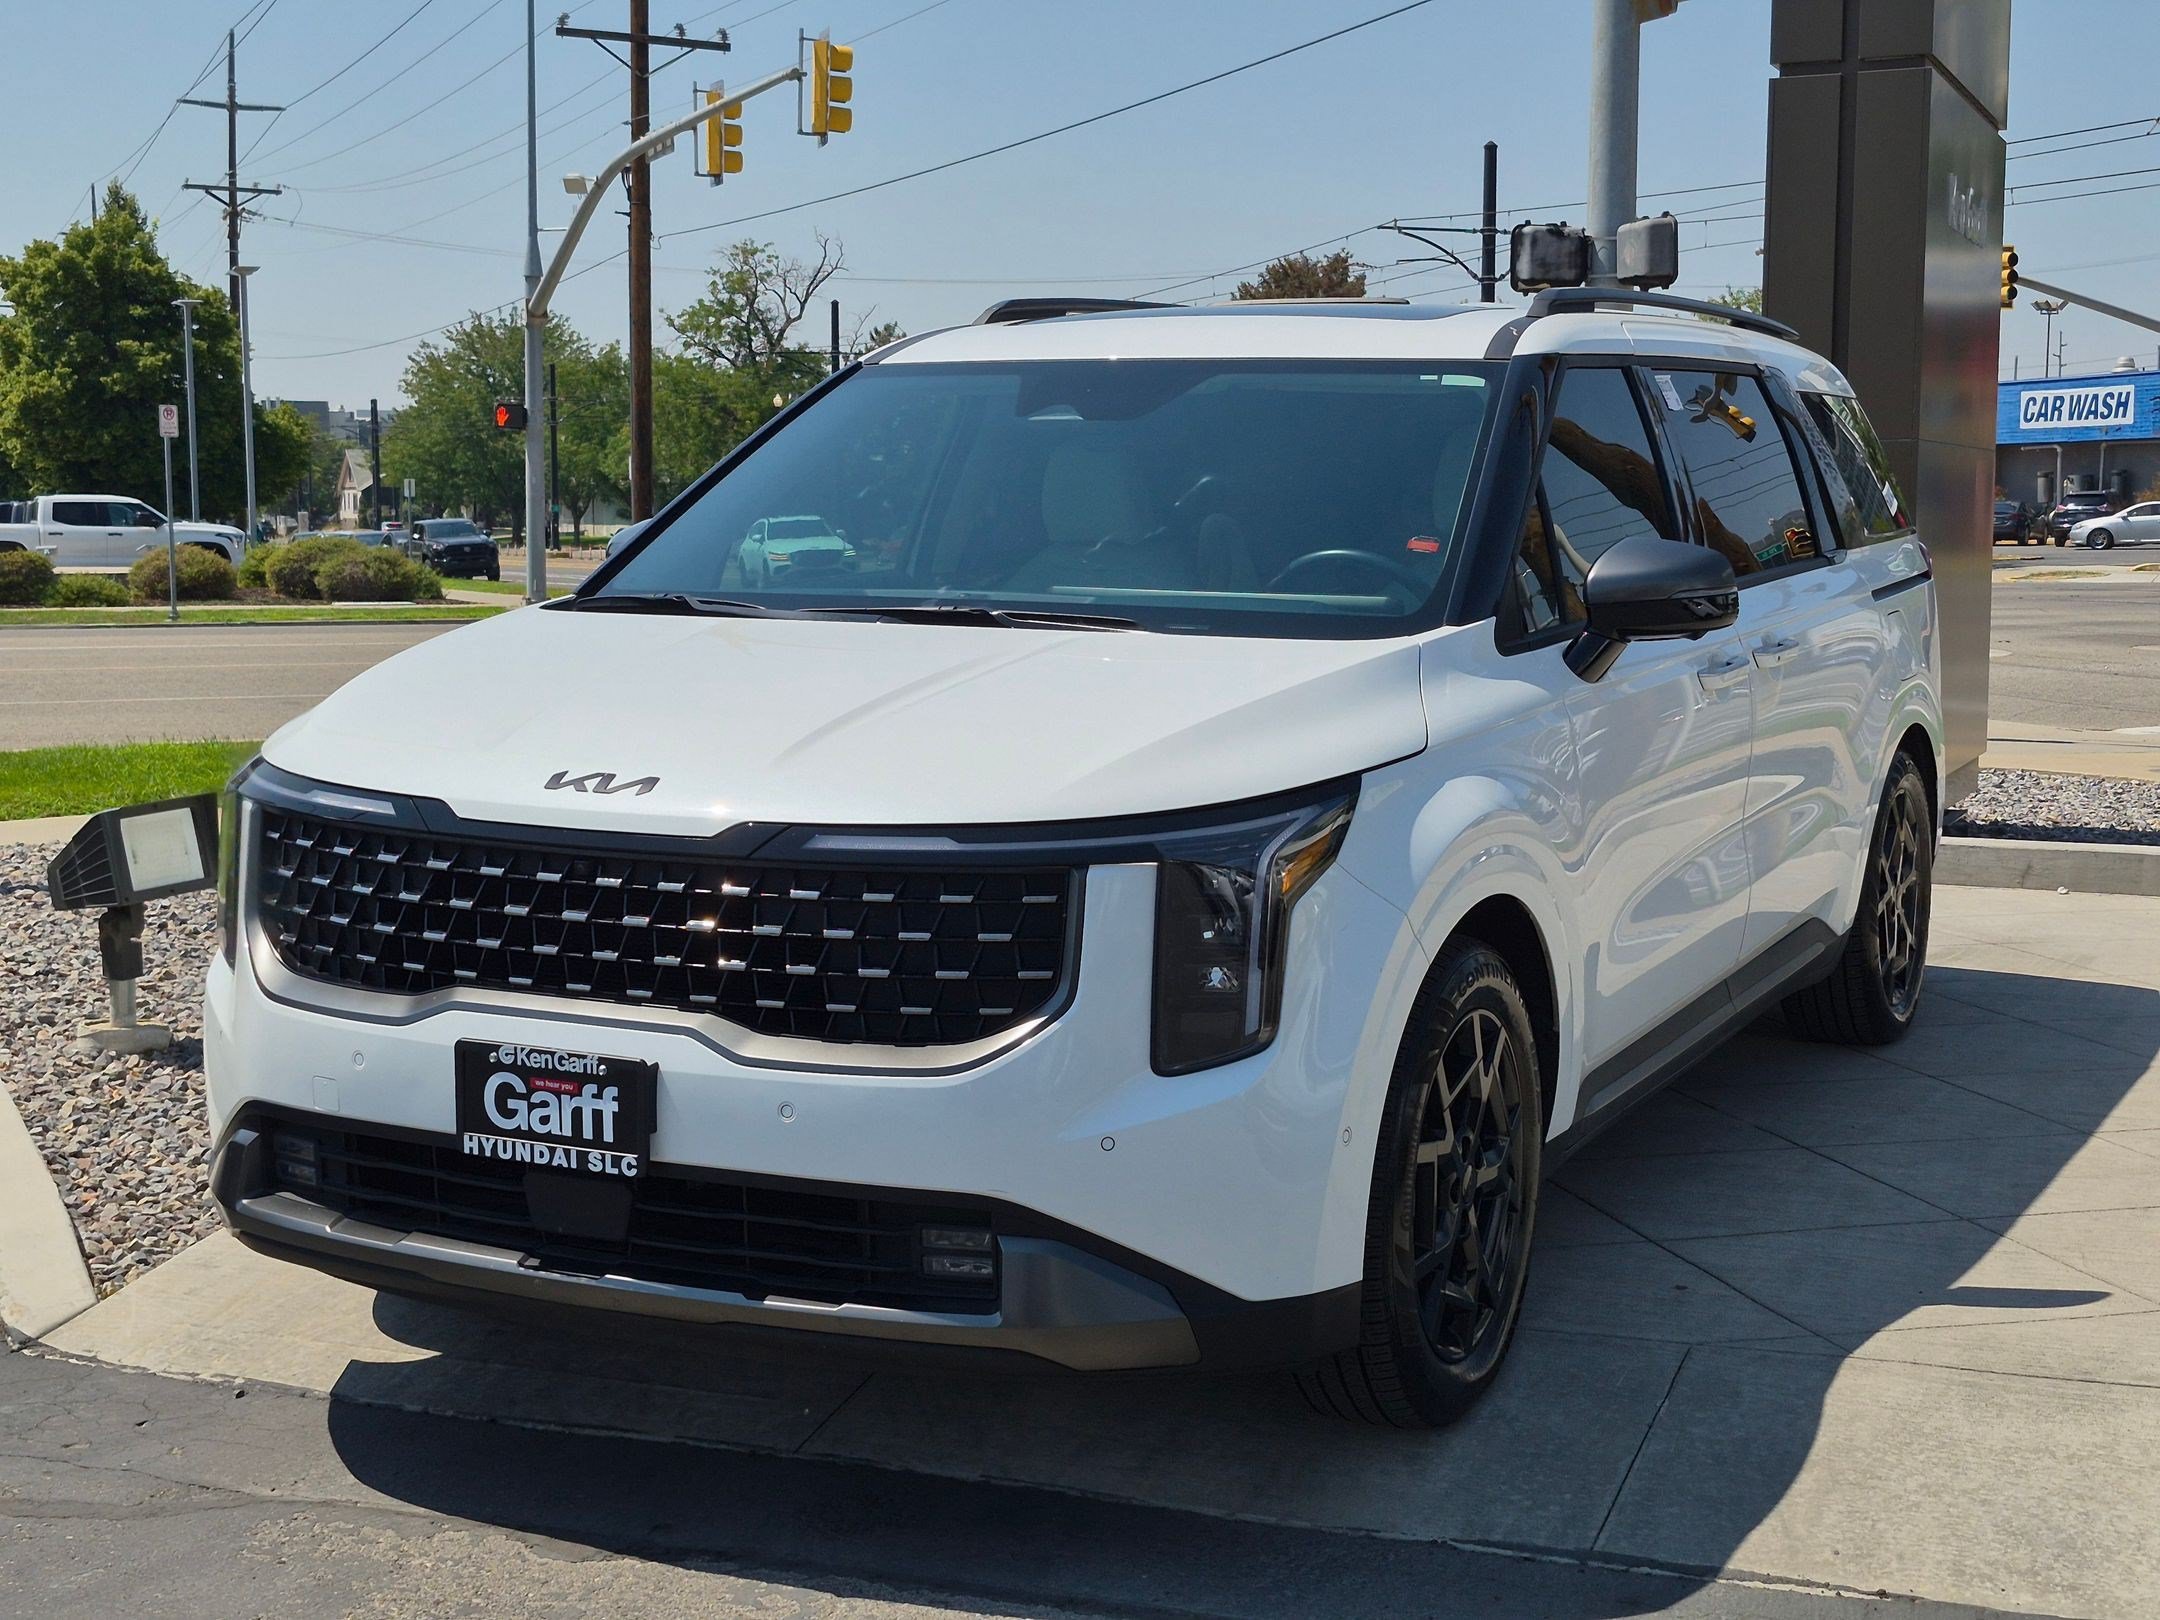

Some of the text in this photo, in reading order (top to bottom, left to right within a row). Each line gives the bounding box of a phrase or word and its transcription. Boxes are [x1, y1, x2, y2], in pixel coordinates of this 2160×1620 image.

[2022, 391, 2131, 424] CAR WASH
[545, 1080, 560, 1089] hear
[561, 1083, 574, 1091] you
[483, 1071, 619, 1143] Garff
[463, 1134, 638, 1178] HYUNDAI SLC
